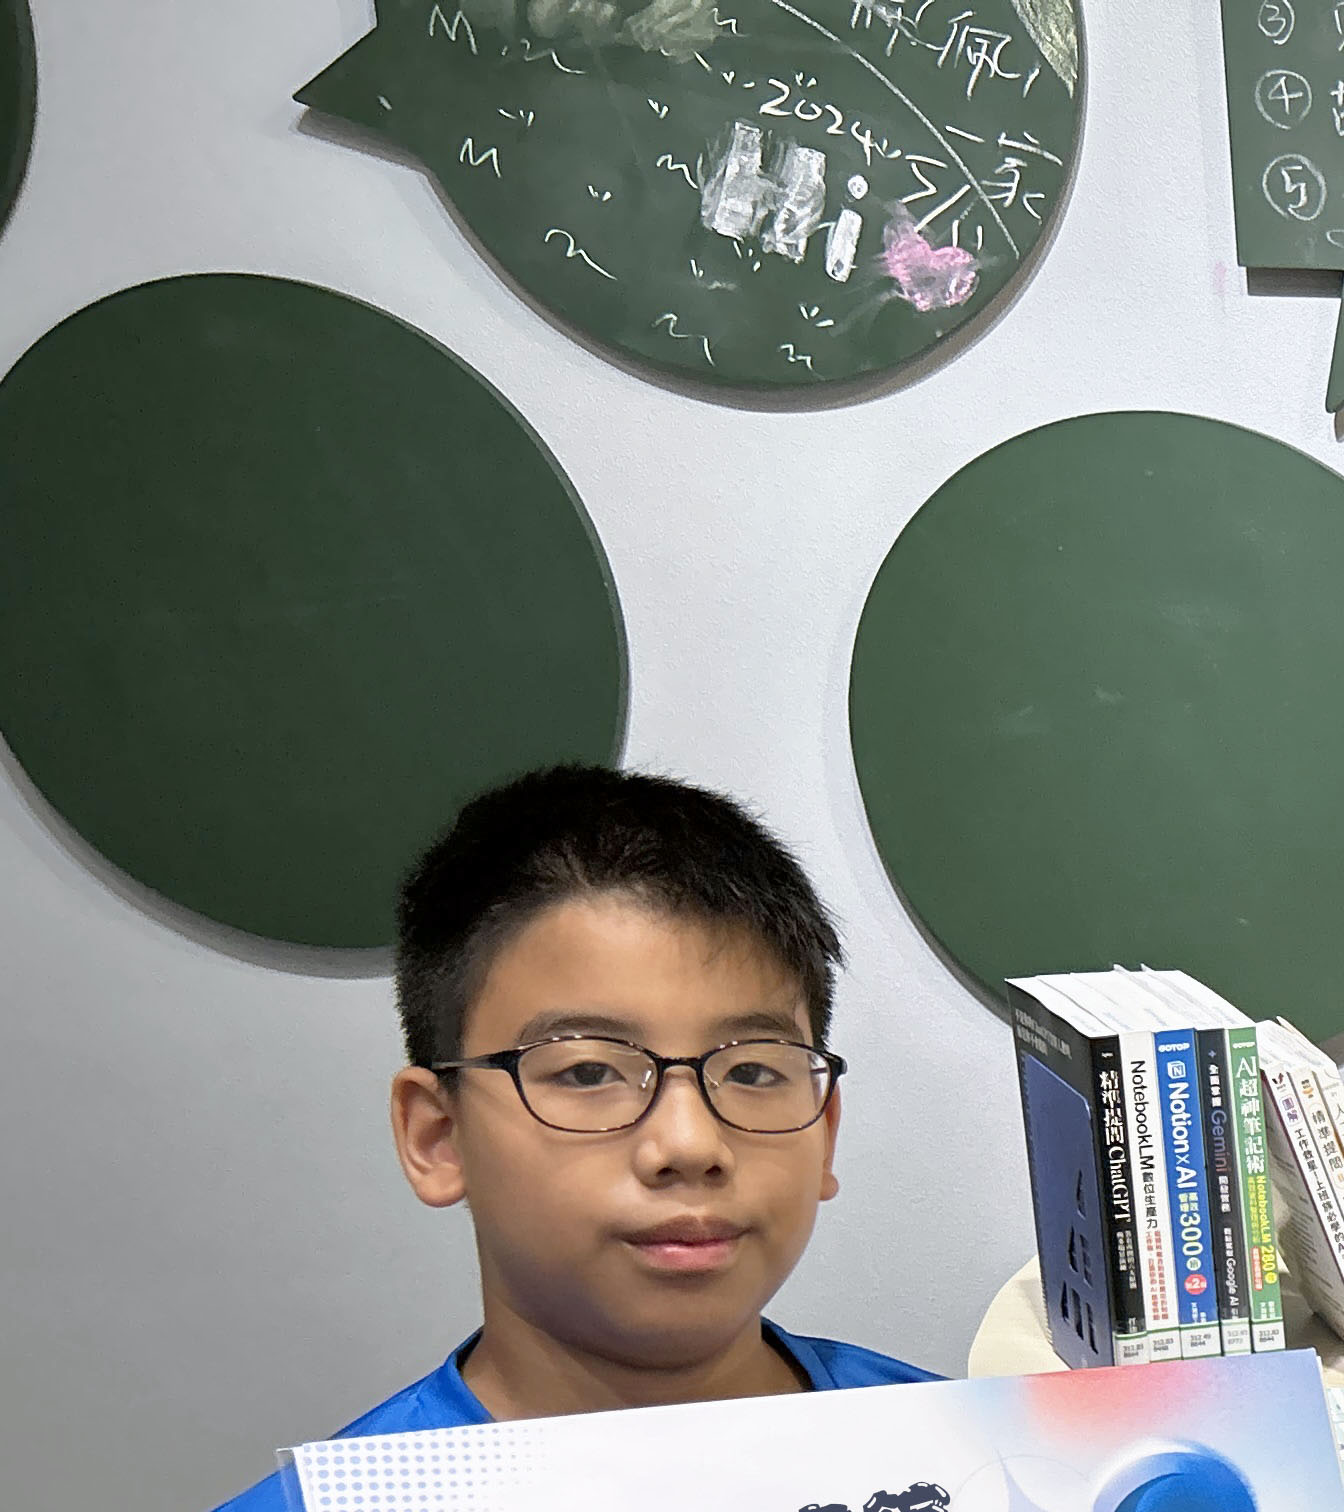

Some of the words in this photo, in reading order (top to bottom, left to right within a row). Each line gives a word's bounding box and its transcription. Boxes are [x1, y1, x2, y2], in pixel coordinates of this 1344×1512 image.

[1130, 1060, 1156, 1171] NotebookLM
[1210, 1109, 1229, 1172] Gemini
[1179, 1213, 1204, 1257] 300
